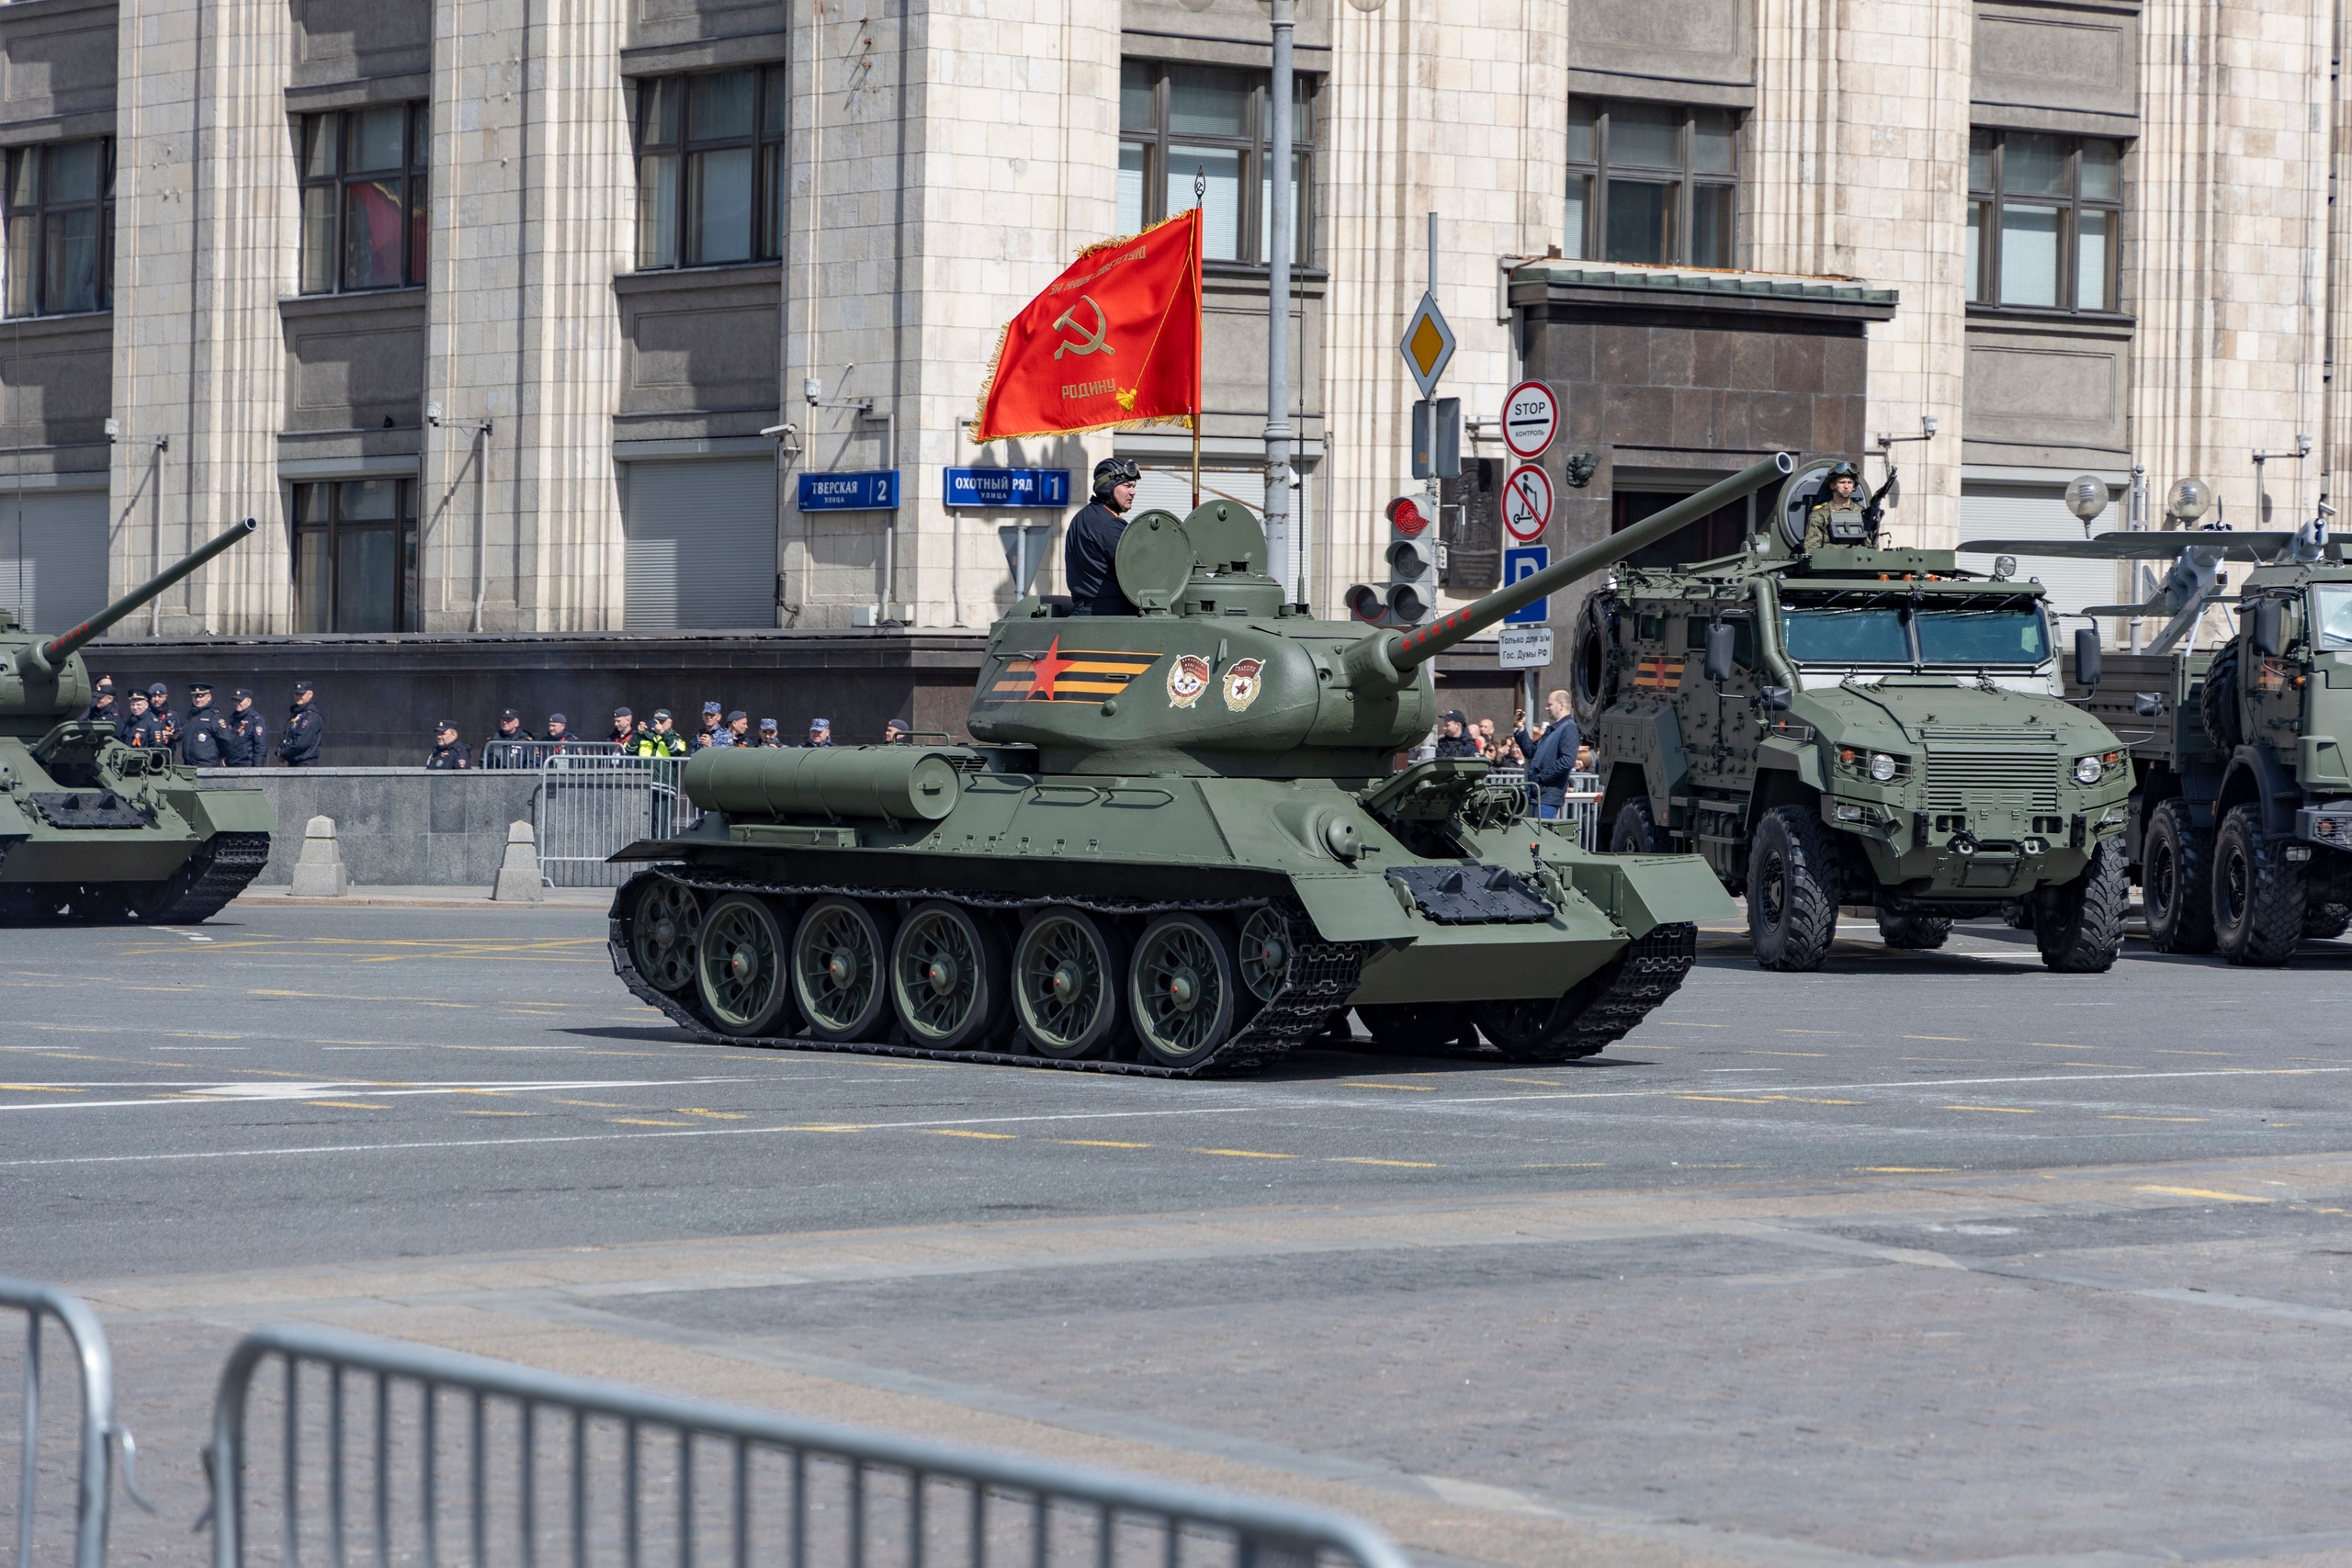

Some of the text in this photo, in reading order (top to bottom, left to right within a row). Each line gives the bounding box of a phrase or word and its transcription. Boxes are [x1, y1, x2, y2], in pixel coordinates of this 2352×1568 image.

[1048, 283, 1064, 296] ЗА
[1064, 274, 1093, 291] НАШУ
[1061, 378, 1116, 400] РОДИНУ
[1514, 401, 1546, 416] STOP
[1515, 429, 1545, 437] КОНТРОЛЬ
[811, 480, 859, 495] ТВЕРСКАЯ
[876, 479, 888, 502] 2
[955, 476, 1034, 491] ОХОТНЫЙ РЯД
[1050, 476, 1059, 500] 1
[1500, 636, 1524, 645] Только
[1525, 636, 1538, 645] для
[1502, 649, 1548, 660] Гос. Думы РФ
